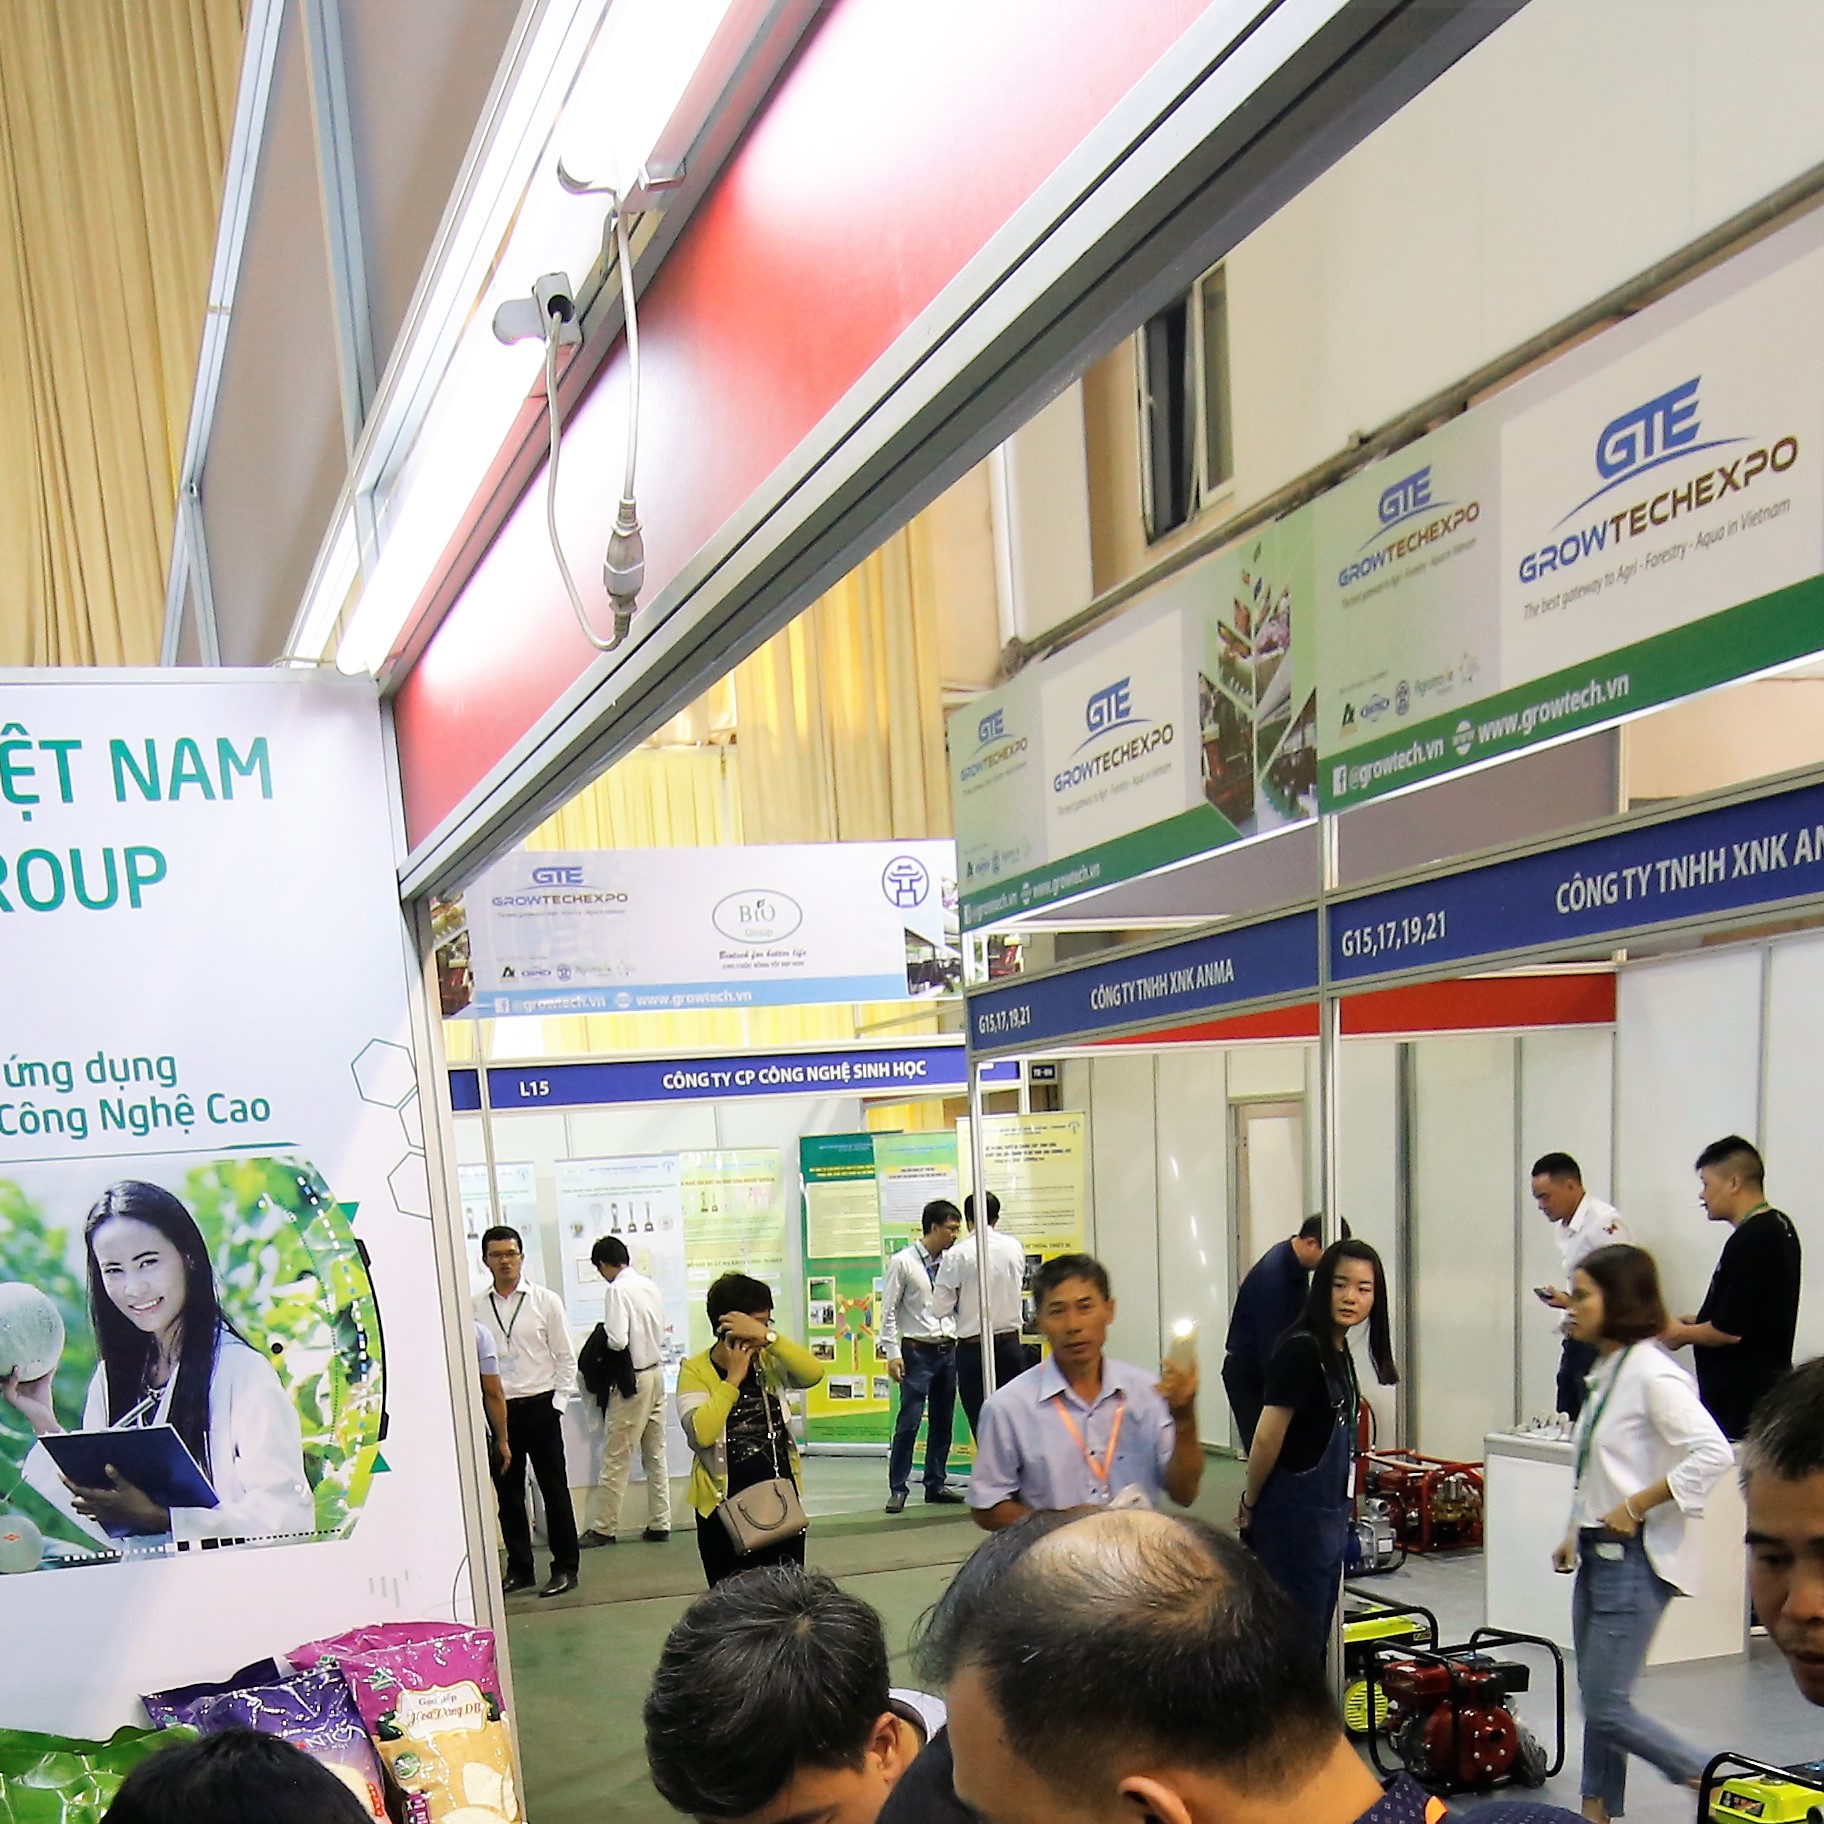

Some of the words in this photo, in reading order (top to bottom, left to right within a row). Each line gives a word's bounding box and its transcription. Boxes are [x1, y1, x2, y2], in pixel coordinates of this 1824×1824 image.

[1596, 375, 1701, 480] GTE
[1379, 465, 1432, 524] GTE
[1519, 435, 1799, 584] GROWTECHEXPO
[1338, 501, 1480, 588] GROWTECHEXPO
[1561, 580, 1603, 609] gateway
[1694, 527, 1724, 549] Aqua
[1740, 498, 1791, 531] Vietnam
[1086, 676, 1133, 732] GTE
[1477, 672, 1630, 745] www.growtech.vn
[110, 735, 274, 805] NAM
[1053, 723, 1175, 793] GROWTECHEXPO
[492, 893, 628, 907] GROWTECHEXPO
[532, 865, 584, 886] GTE
[1341, 912, 1447, 960] G15,17,19,21
[1555, 872, 1619, 917] CÔNG
[1622, 866, 1654, 901] TY
[1657, 853, 1726, 895] TNHH
[1730, 836, 1788, 881] XNK
[636, 990, 752, 1007] www.growtech.vn
[1090, 979, 1121, 1011] CÔNG
[1121, 977, 1137, 1003] TY
[1138, 970, 1170, 1001] TNHH
[1170, 965, 1195, 995] XNK
[1196, 958, 1235, 988] ANMA
[1, 1054, 74, 1098] ứng
[83, 1049, 179, 1099] dụng
[520, 1079, 550, 1098] L15
[663, 1070, 711, 1091] CÔNG
[713, 1072, 733, 1089] TY
[734, 1069, 757, 1087] CP
[758, 1064, 805, 1086] CÔNG
[806, 1062, 852, 1086] NGHỆ
[853, 1062, 891, 1081] SINH
[892, 1059, 928, 1081] HỌC
[99, 1092, 196, 1139] Nghệ
[205, 1090, 271, 1127] Cao
